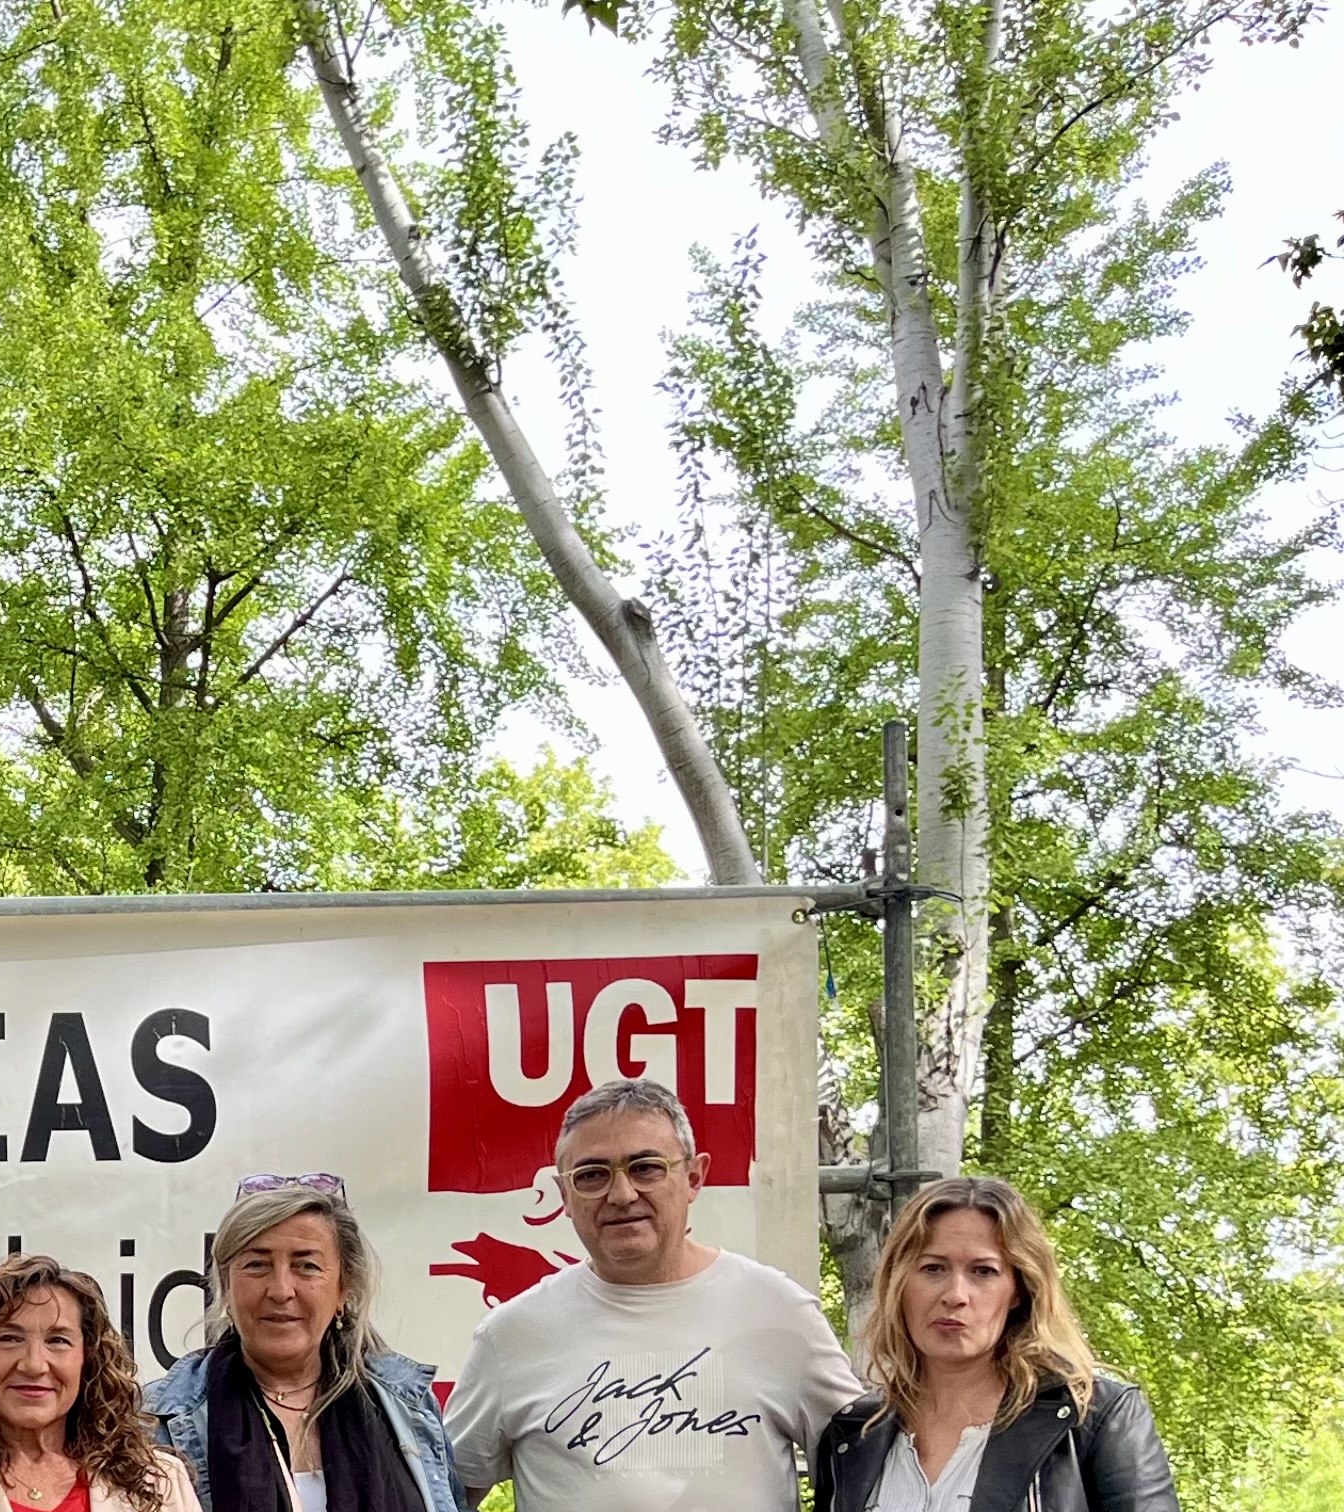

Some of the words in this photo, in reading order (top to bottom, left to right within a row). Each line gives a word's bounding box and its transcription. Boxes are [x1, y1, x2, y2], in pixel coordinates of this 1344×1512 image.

[484, 977, 757, 1107] UGT
[544, 1346, 712, 1434] Jack
[566, 1411, 602, 1450] &
[593, 1396, 761, 1466] Jones
